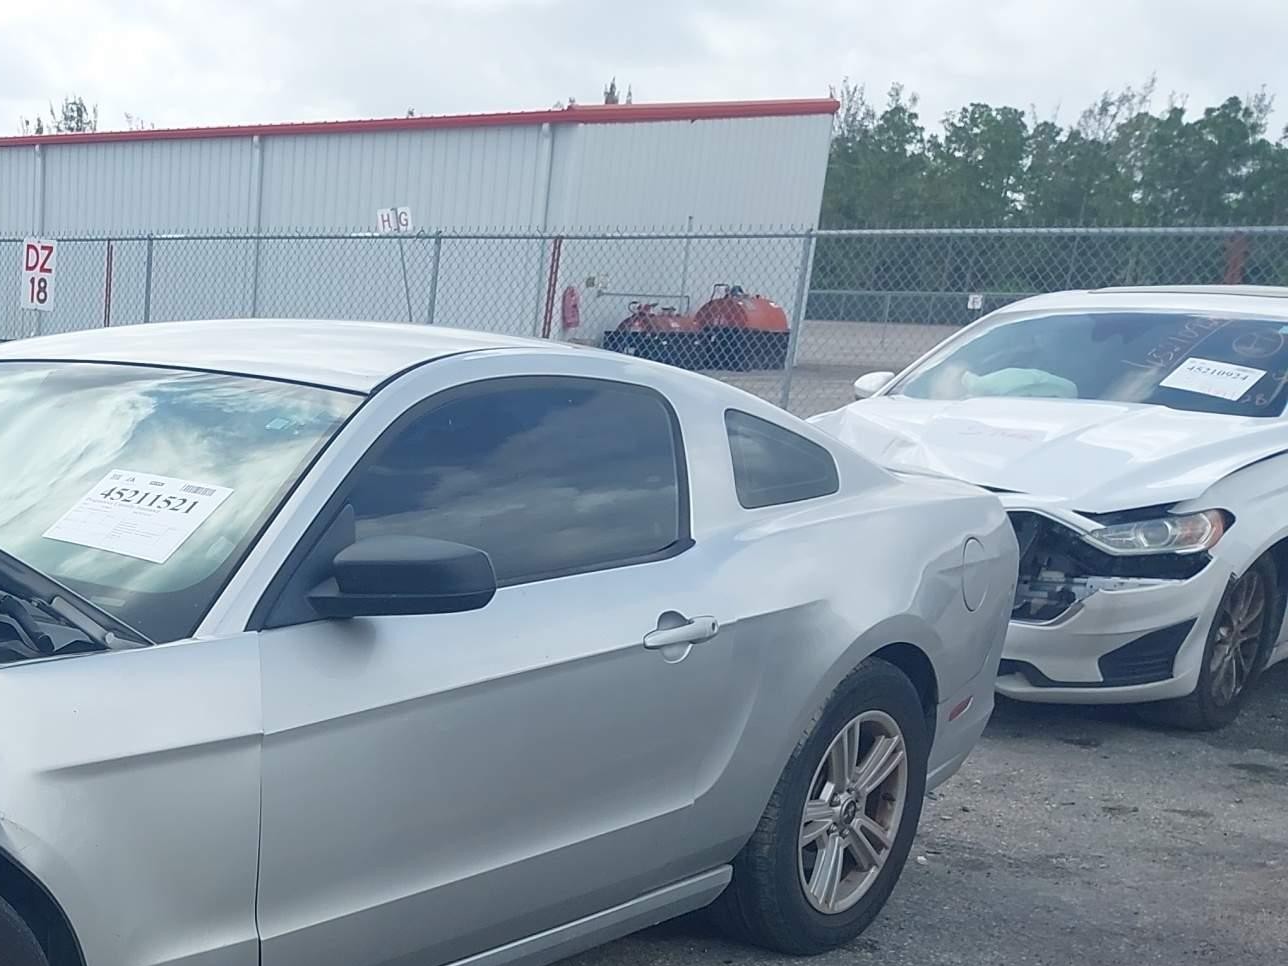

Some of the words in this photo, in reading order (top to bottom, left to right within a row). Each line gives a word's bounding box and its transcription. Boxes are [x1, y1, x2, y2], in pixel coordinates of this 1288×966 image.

[380, 213, 392, 230] H
[398, 211, 409, 227] G
[25, 244, 53, 273] DZ
[30, 276, 47, 304] 18
[100, 486, 199, 514] 45211521
